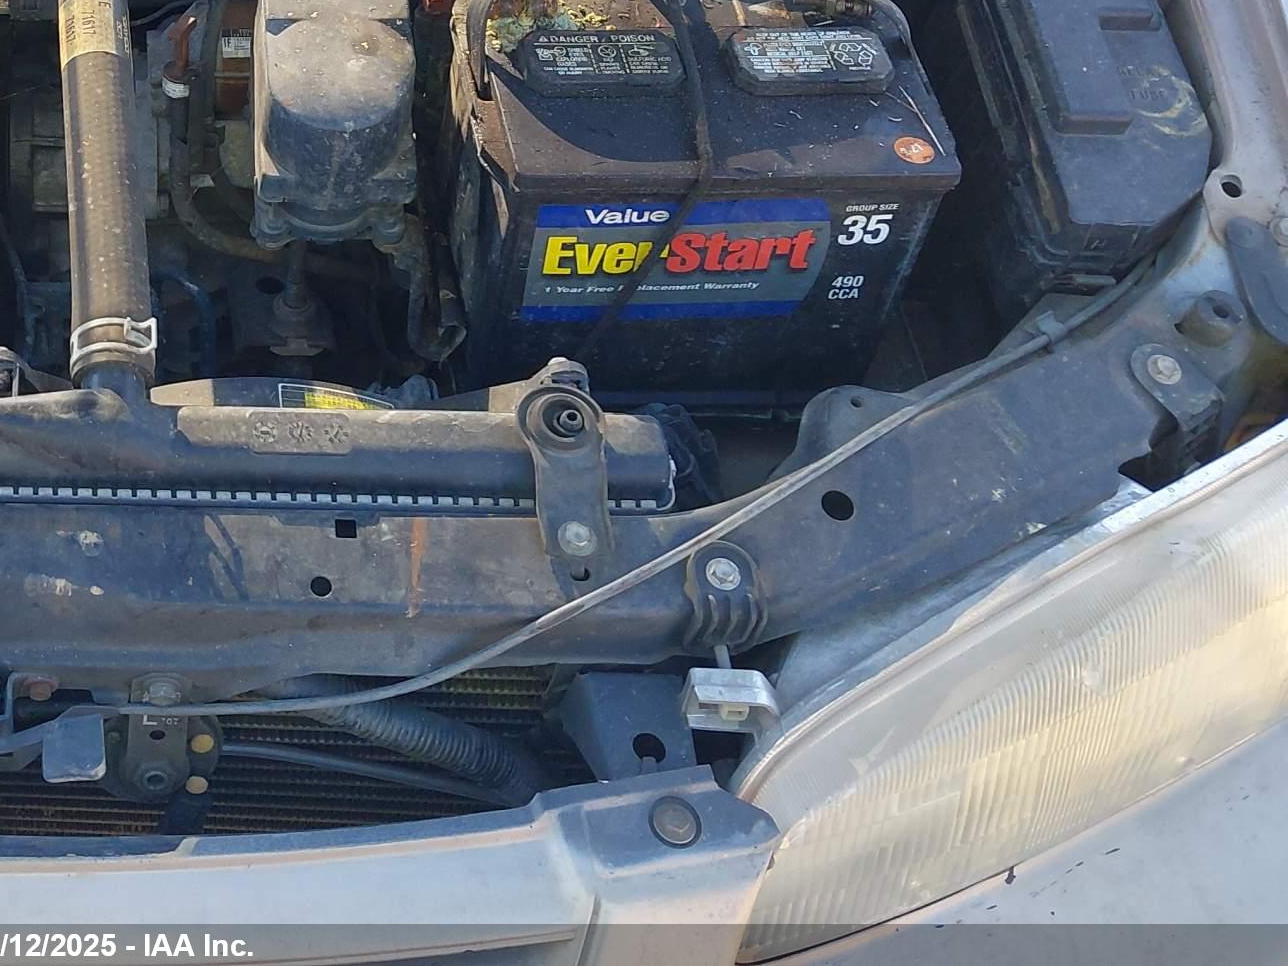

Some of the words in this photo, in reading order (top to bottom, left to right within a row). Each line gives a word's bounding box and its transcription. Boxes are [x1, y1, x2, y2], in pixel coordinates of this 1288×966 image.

[610, 34, 656, 42] POISON
[845, 204, 878, 212] GROUP
[879, 203, 900, 211] SIZE
[584, 208, 671, 225] Value
[837, 214, 894, 245] 35
[704, 281, 760, 290] Warranty
[831, 275, 865, 288] 490
[827, 289, 859, 300] CCA
